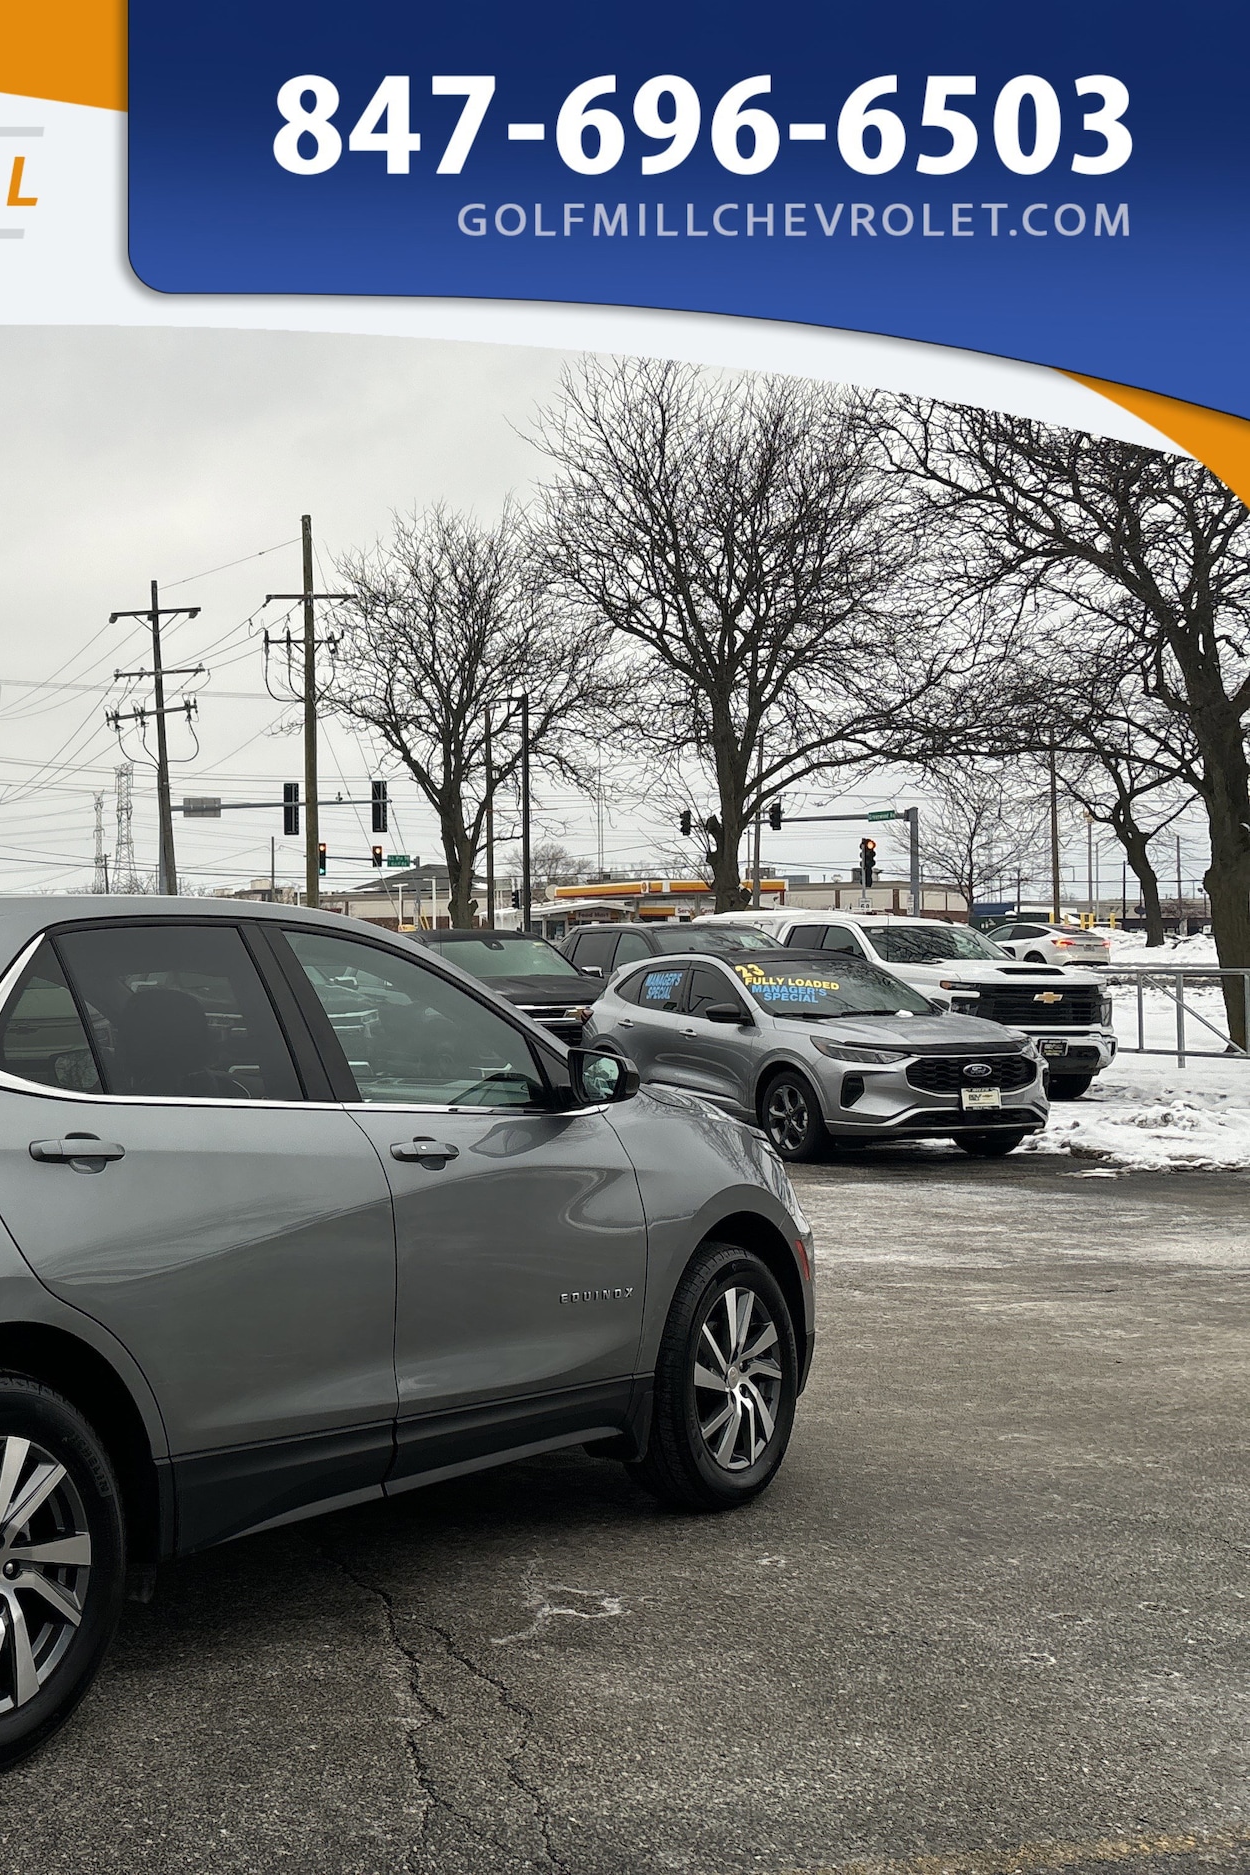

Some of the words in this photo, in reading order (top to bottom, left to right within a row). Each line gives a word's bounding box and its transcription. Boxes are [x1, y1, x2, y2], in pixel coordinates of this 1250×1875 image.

[734, 963, 765, 979] 23
[644, 973, 683, 988] MANAGER'S
[744, 977, 785, 986] FULLY
[788, 978, 840, 991] LOADED
[645, 985, 673, 1000] SPECIAL
[751, 984, 828, 997] MANAGER'S
[763, 992, 819, 1004] SPECIAL
[559, 1286, 634, 1304] EQUINOX
